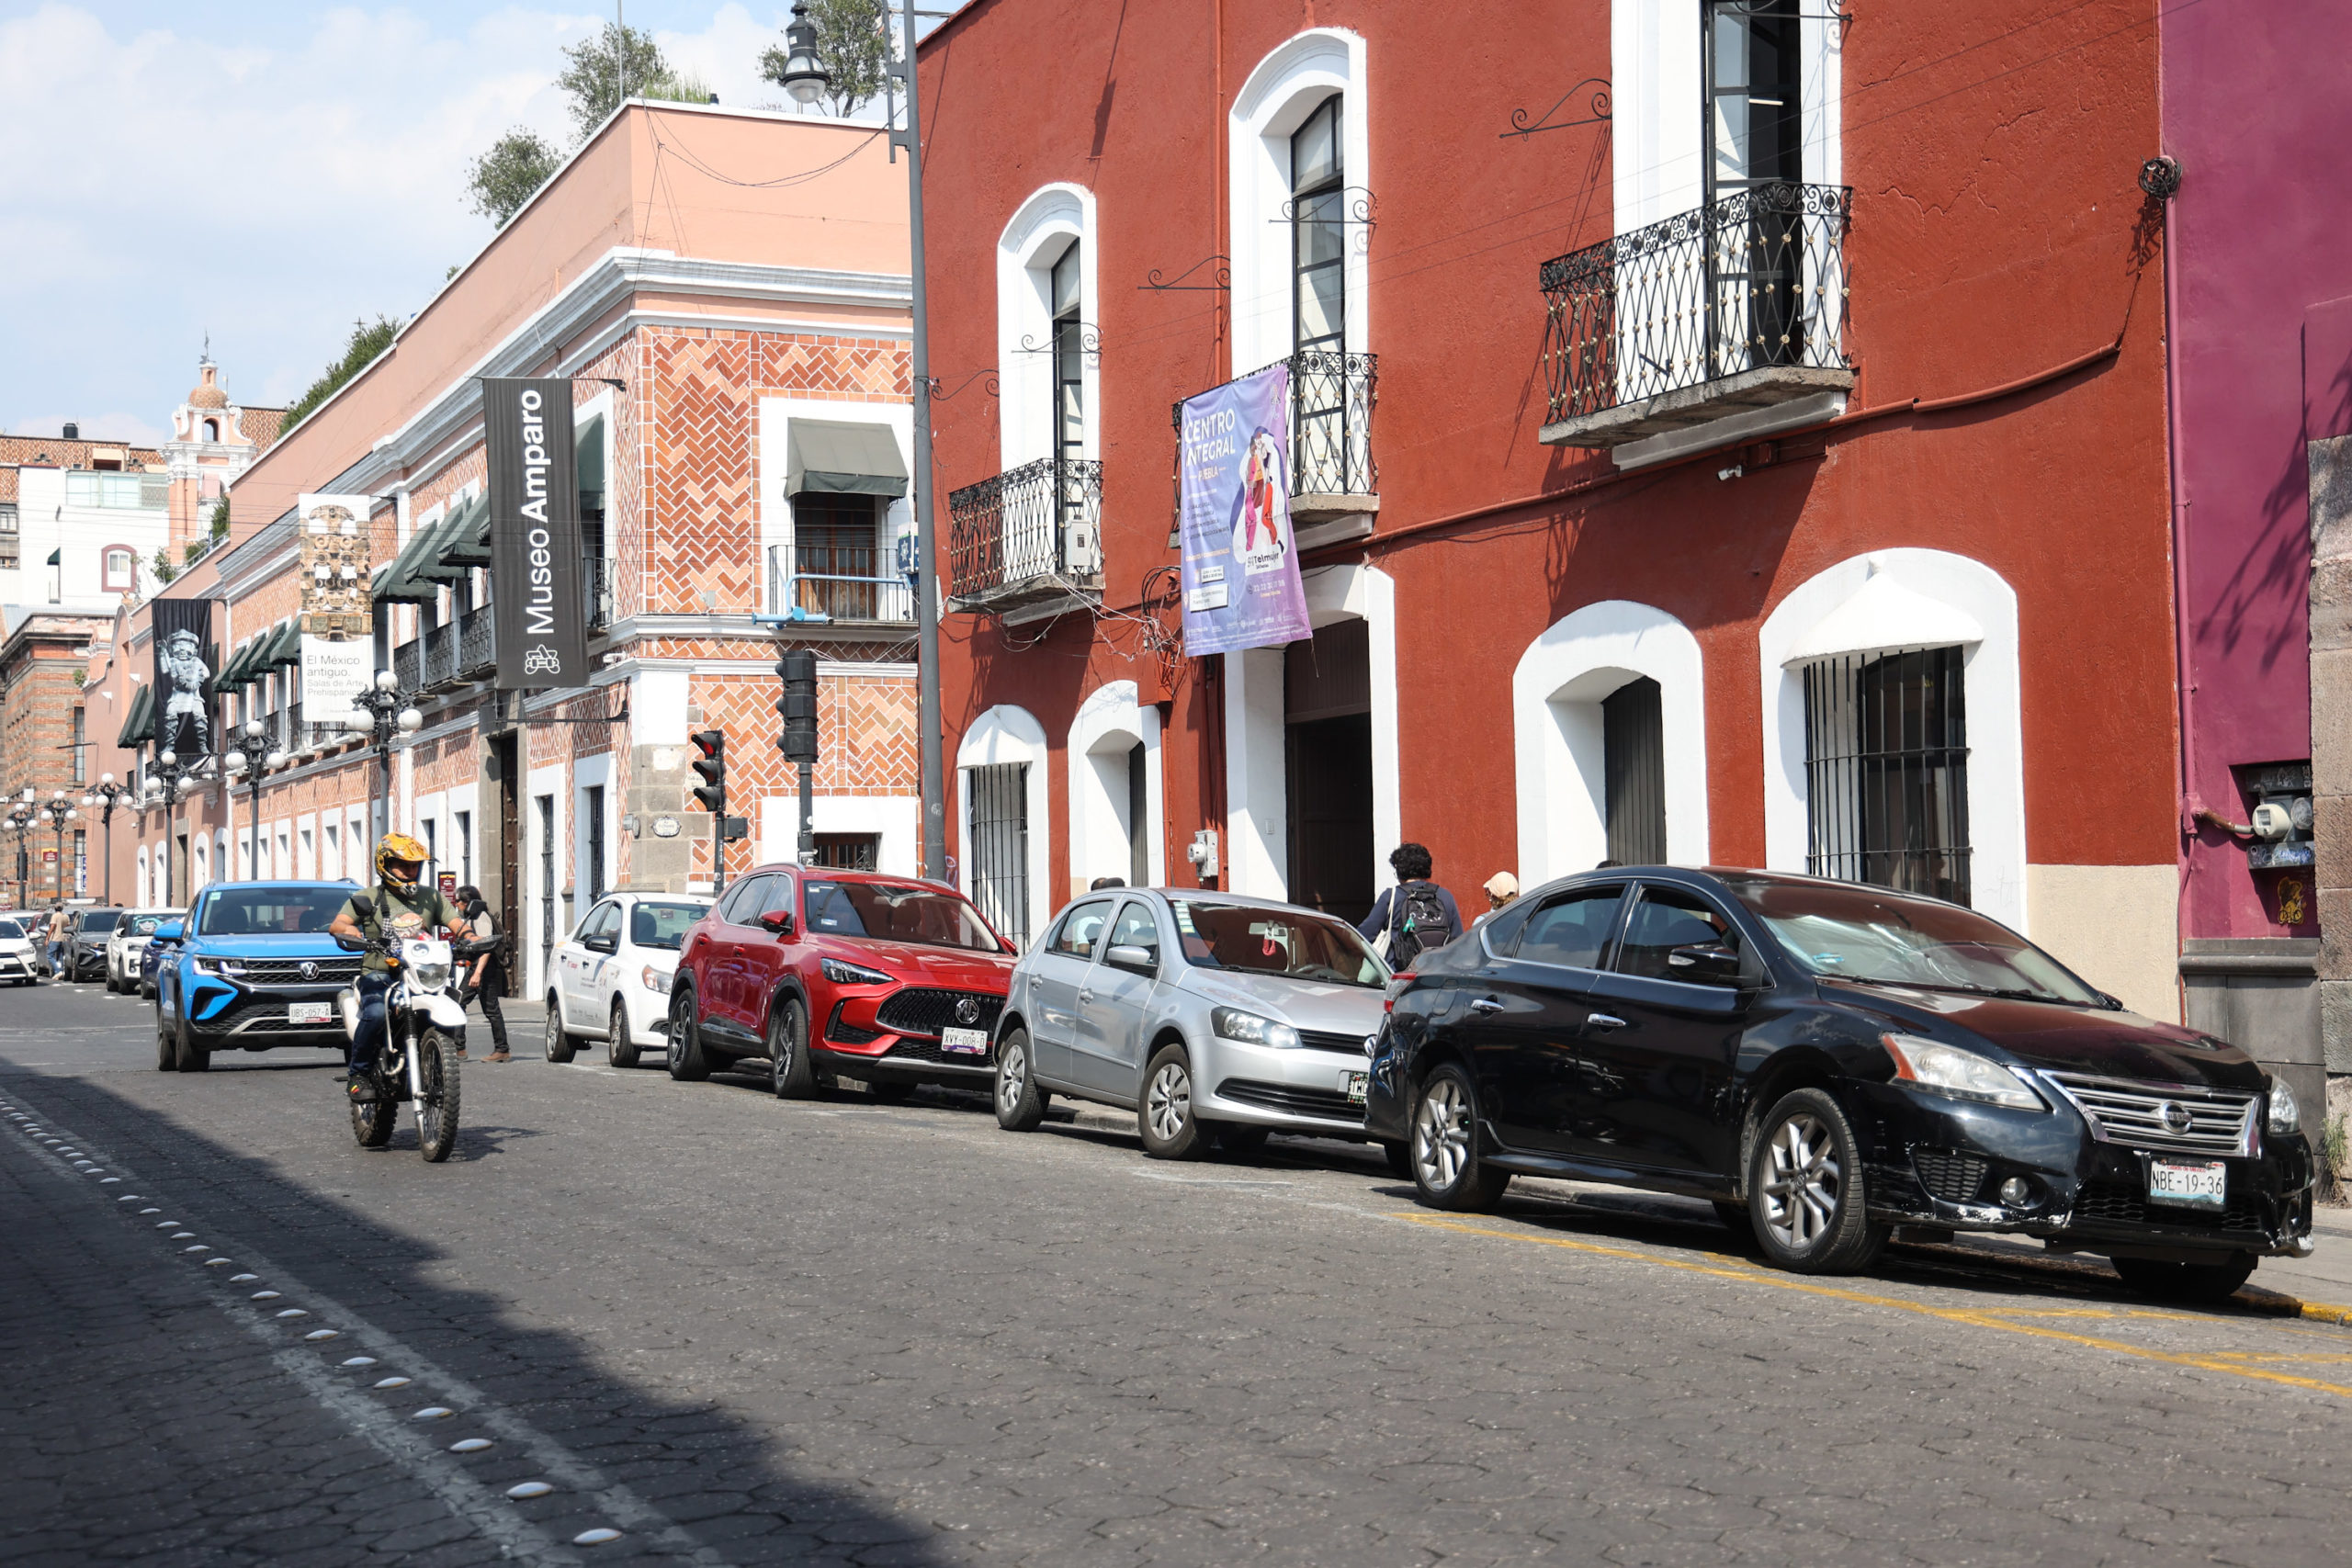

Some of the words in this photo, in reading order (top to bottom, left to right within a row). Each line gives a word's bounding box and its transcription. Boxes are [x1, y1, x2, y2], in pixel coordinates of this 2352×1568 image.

[1184, 408, 1236, 444] CENTRO
[521, 389, 551, 524] Amparo
[526, 528, 554, 634] Museo
[307, 655, 317, 665] El
[321, 654, 360, 665] México
[307, 667, 351, 679] antiguo.
[307, 679, 331, 687] Salas
[333, 679, 345, 687] de
[346, 679, 365, 687] Arte
[958, 1000, 977, 1021] MG
[2152, 1169, 2223, 1195] NBE-19-36
